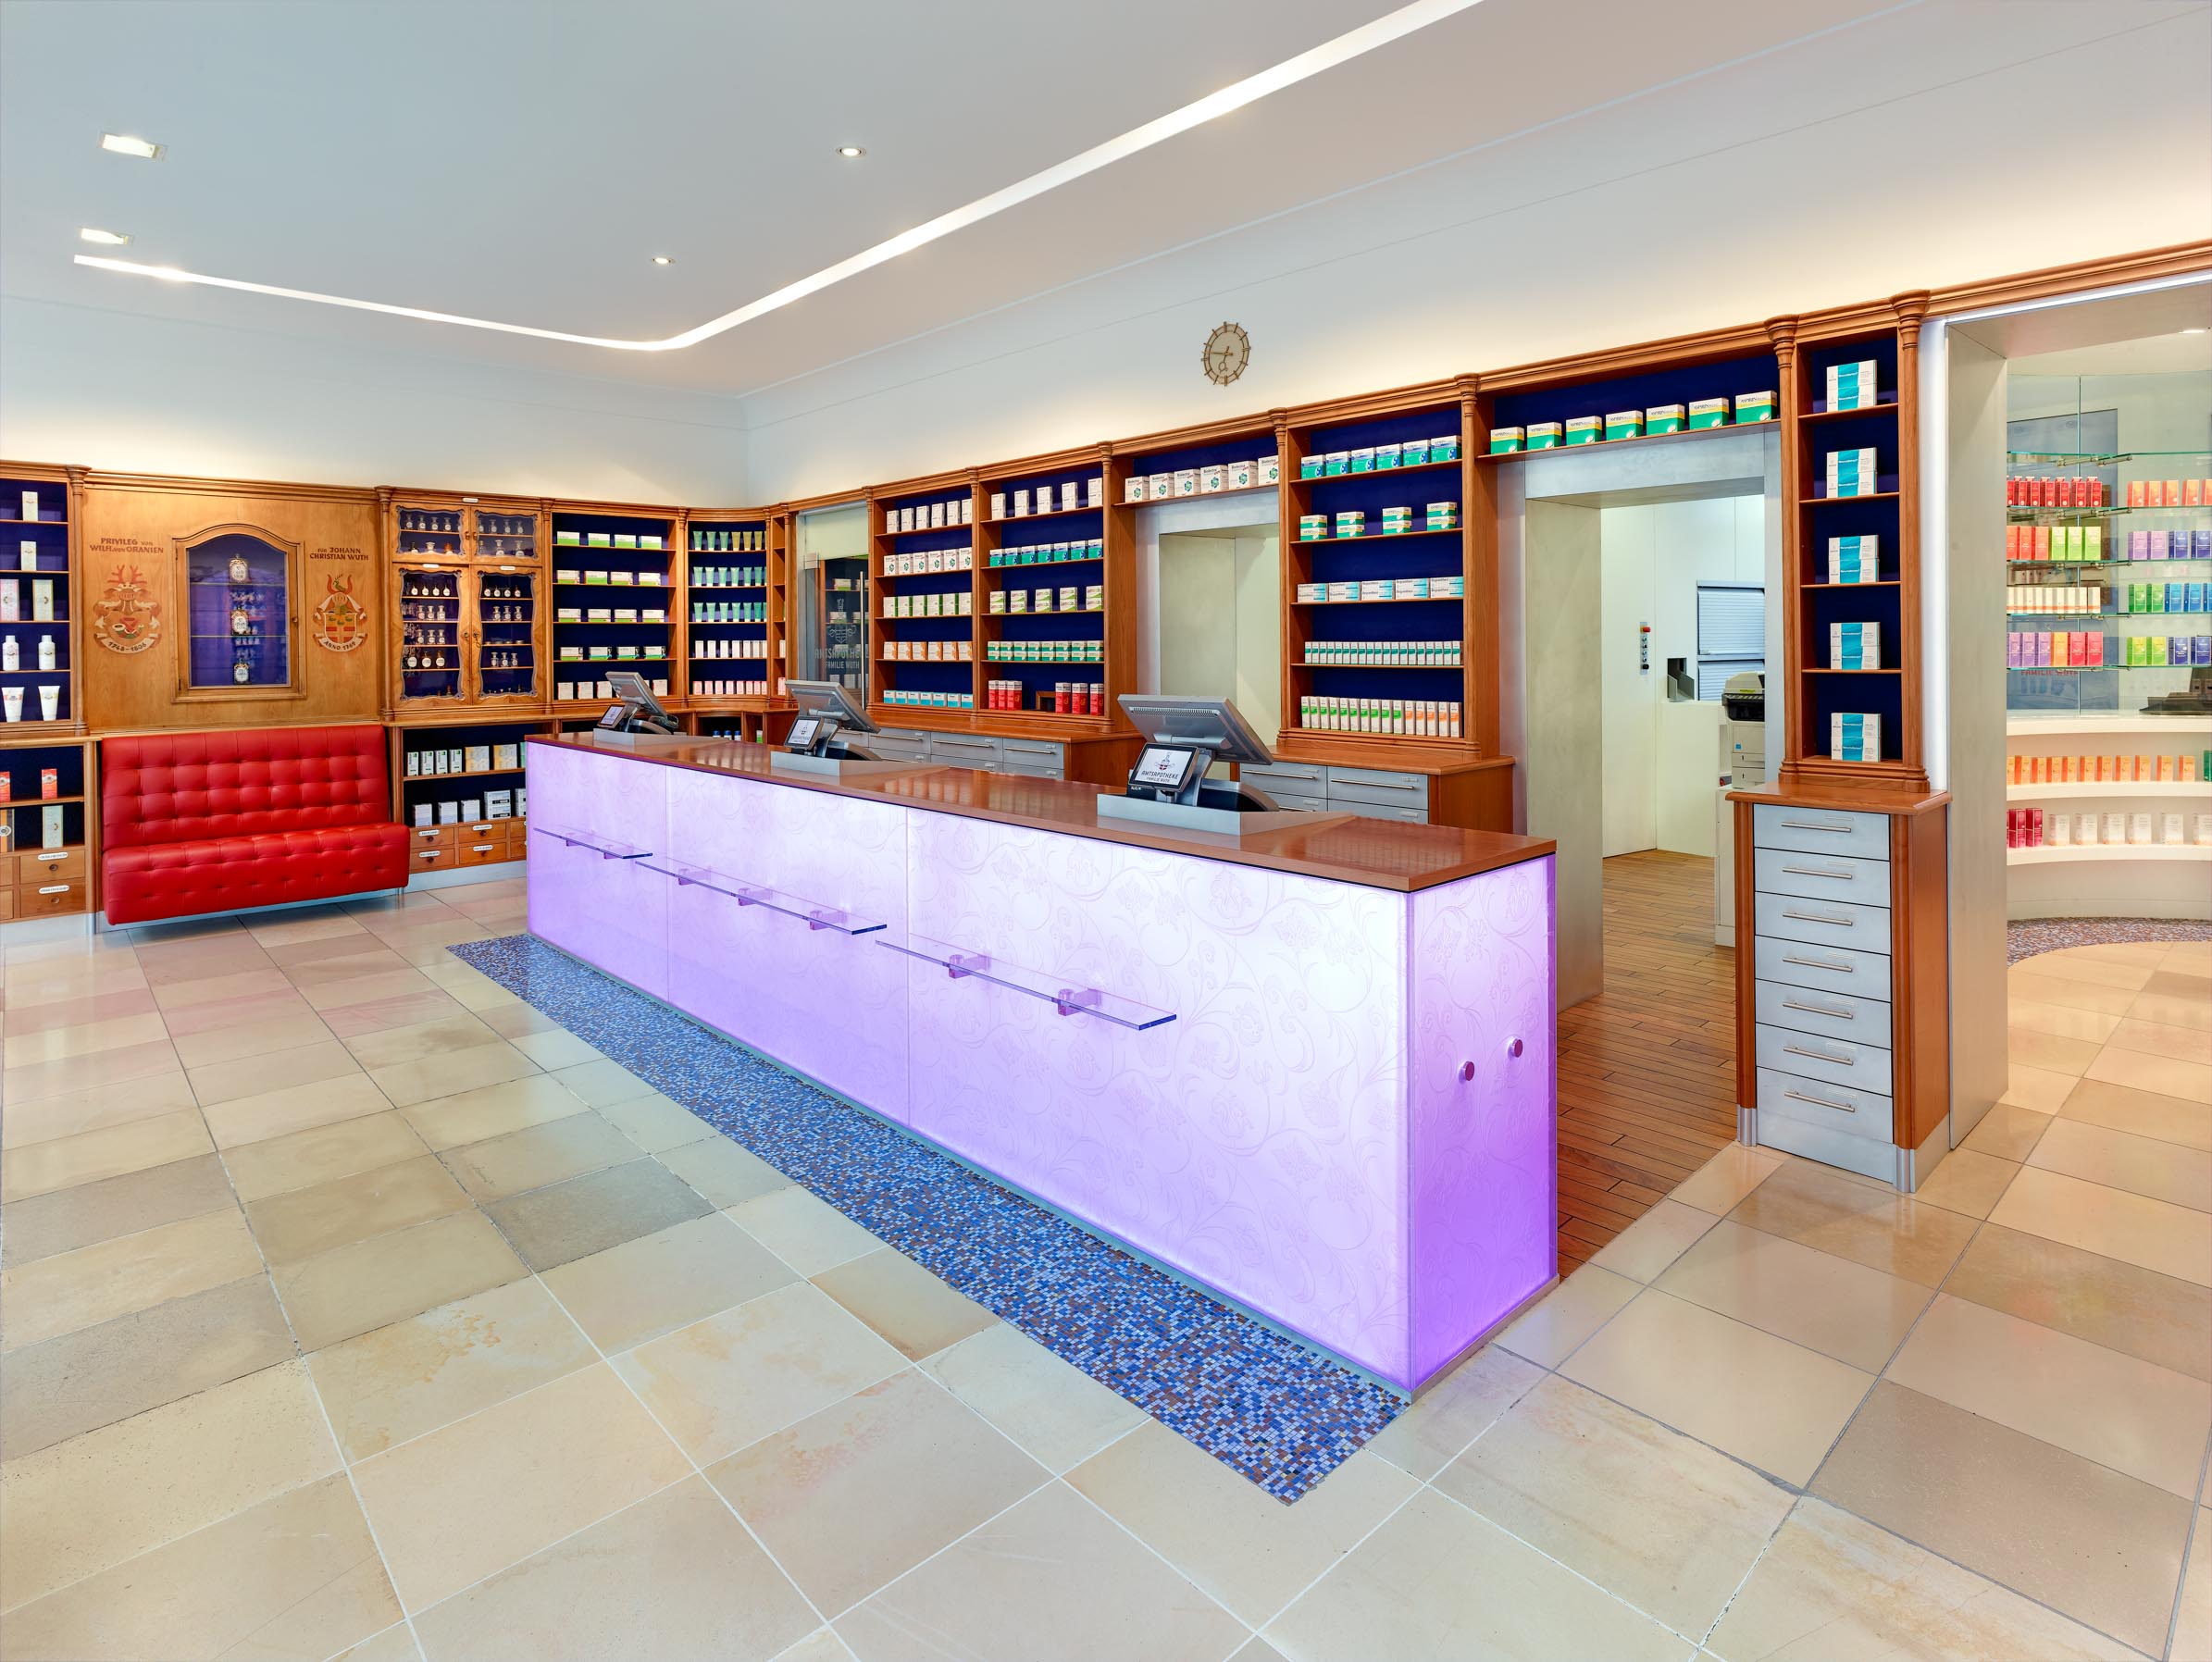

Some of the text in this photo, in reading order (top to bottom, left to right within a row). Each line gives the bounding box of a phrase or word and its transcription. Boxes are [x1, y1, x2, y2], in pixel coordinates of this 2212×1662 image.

[100, 538, 138, 546] PRIVILEG
[324, 641, 342, 651] ANNO
[826, 661, 844, 669] FAMILIE
[1141, 770, 1179, 779] AMTSAPOTHEKE
